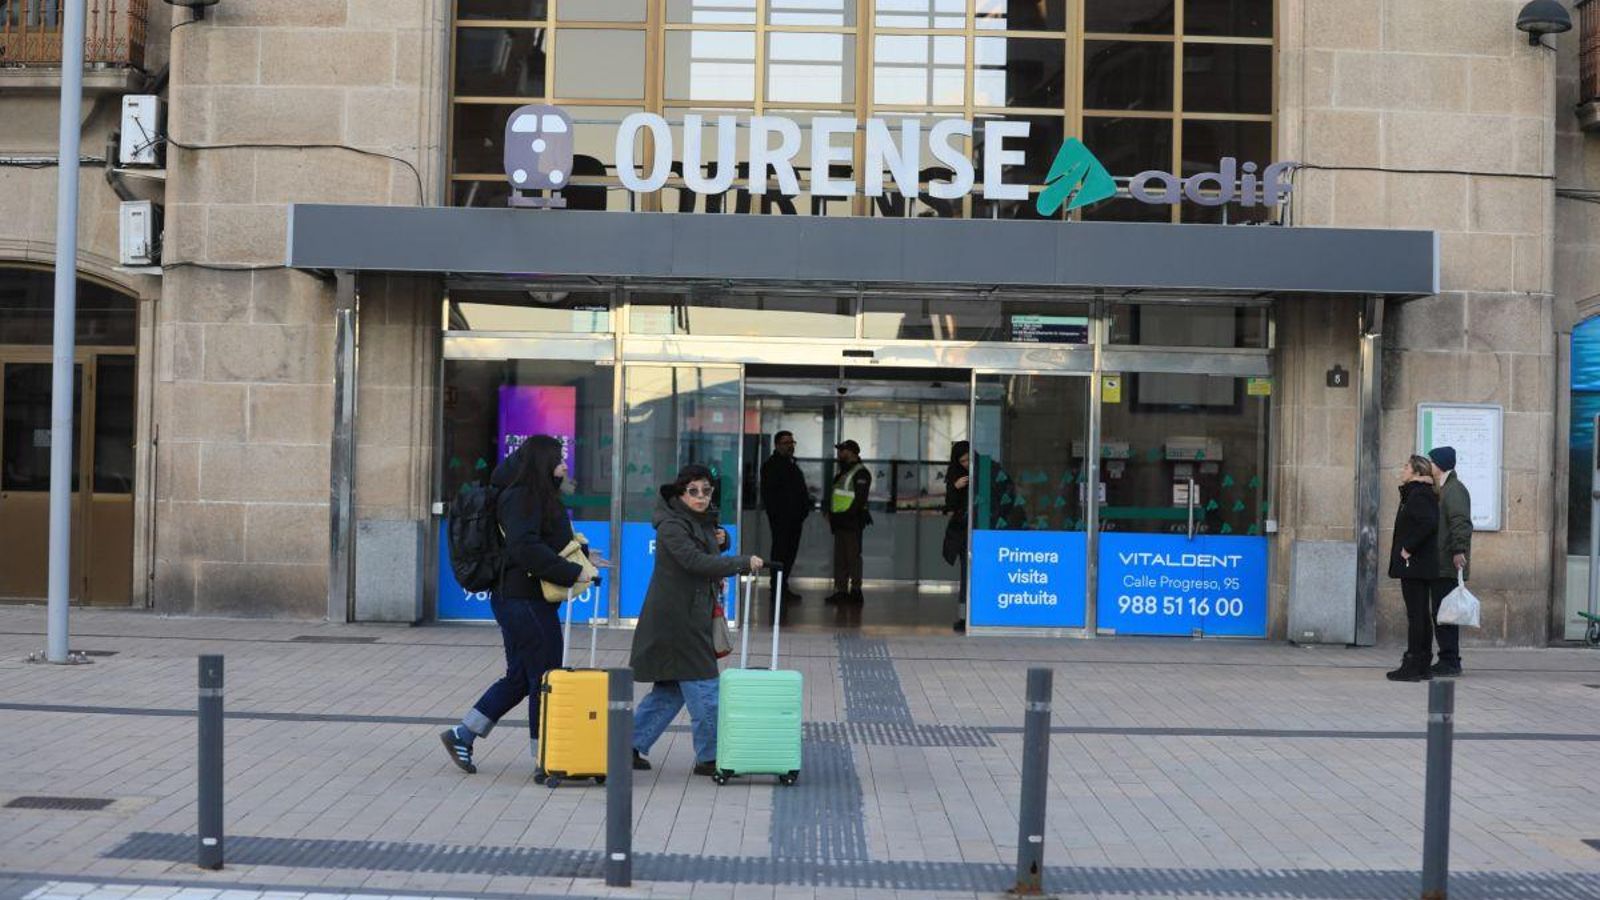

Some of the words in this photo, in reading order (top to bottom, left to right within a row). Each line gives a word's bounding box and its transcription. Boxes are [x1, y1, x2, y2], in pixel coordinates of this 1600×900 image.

[615, 112, 1031, 201] OURENSE
[1129, 157, 1295, 207] adif
[998, 547, 1058, 563] Primera
[1119, 552, 1242, 567] VITALDENT
[1008, 569, 1048, 584] visita
[1123, 575, 1157, 588] Calle
[1160, 576, 1221, 592] Progreso,
[1223, 578, 1240, 590] 95
[998, 591, 1057, 609] gratuita
[1118, 595, 1157, 614] 988
[1163, 596, 1183, 615] 51
[1188, 597, 1209, 616] 16
[1215, 597, 1243, 617] 00
